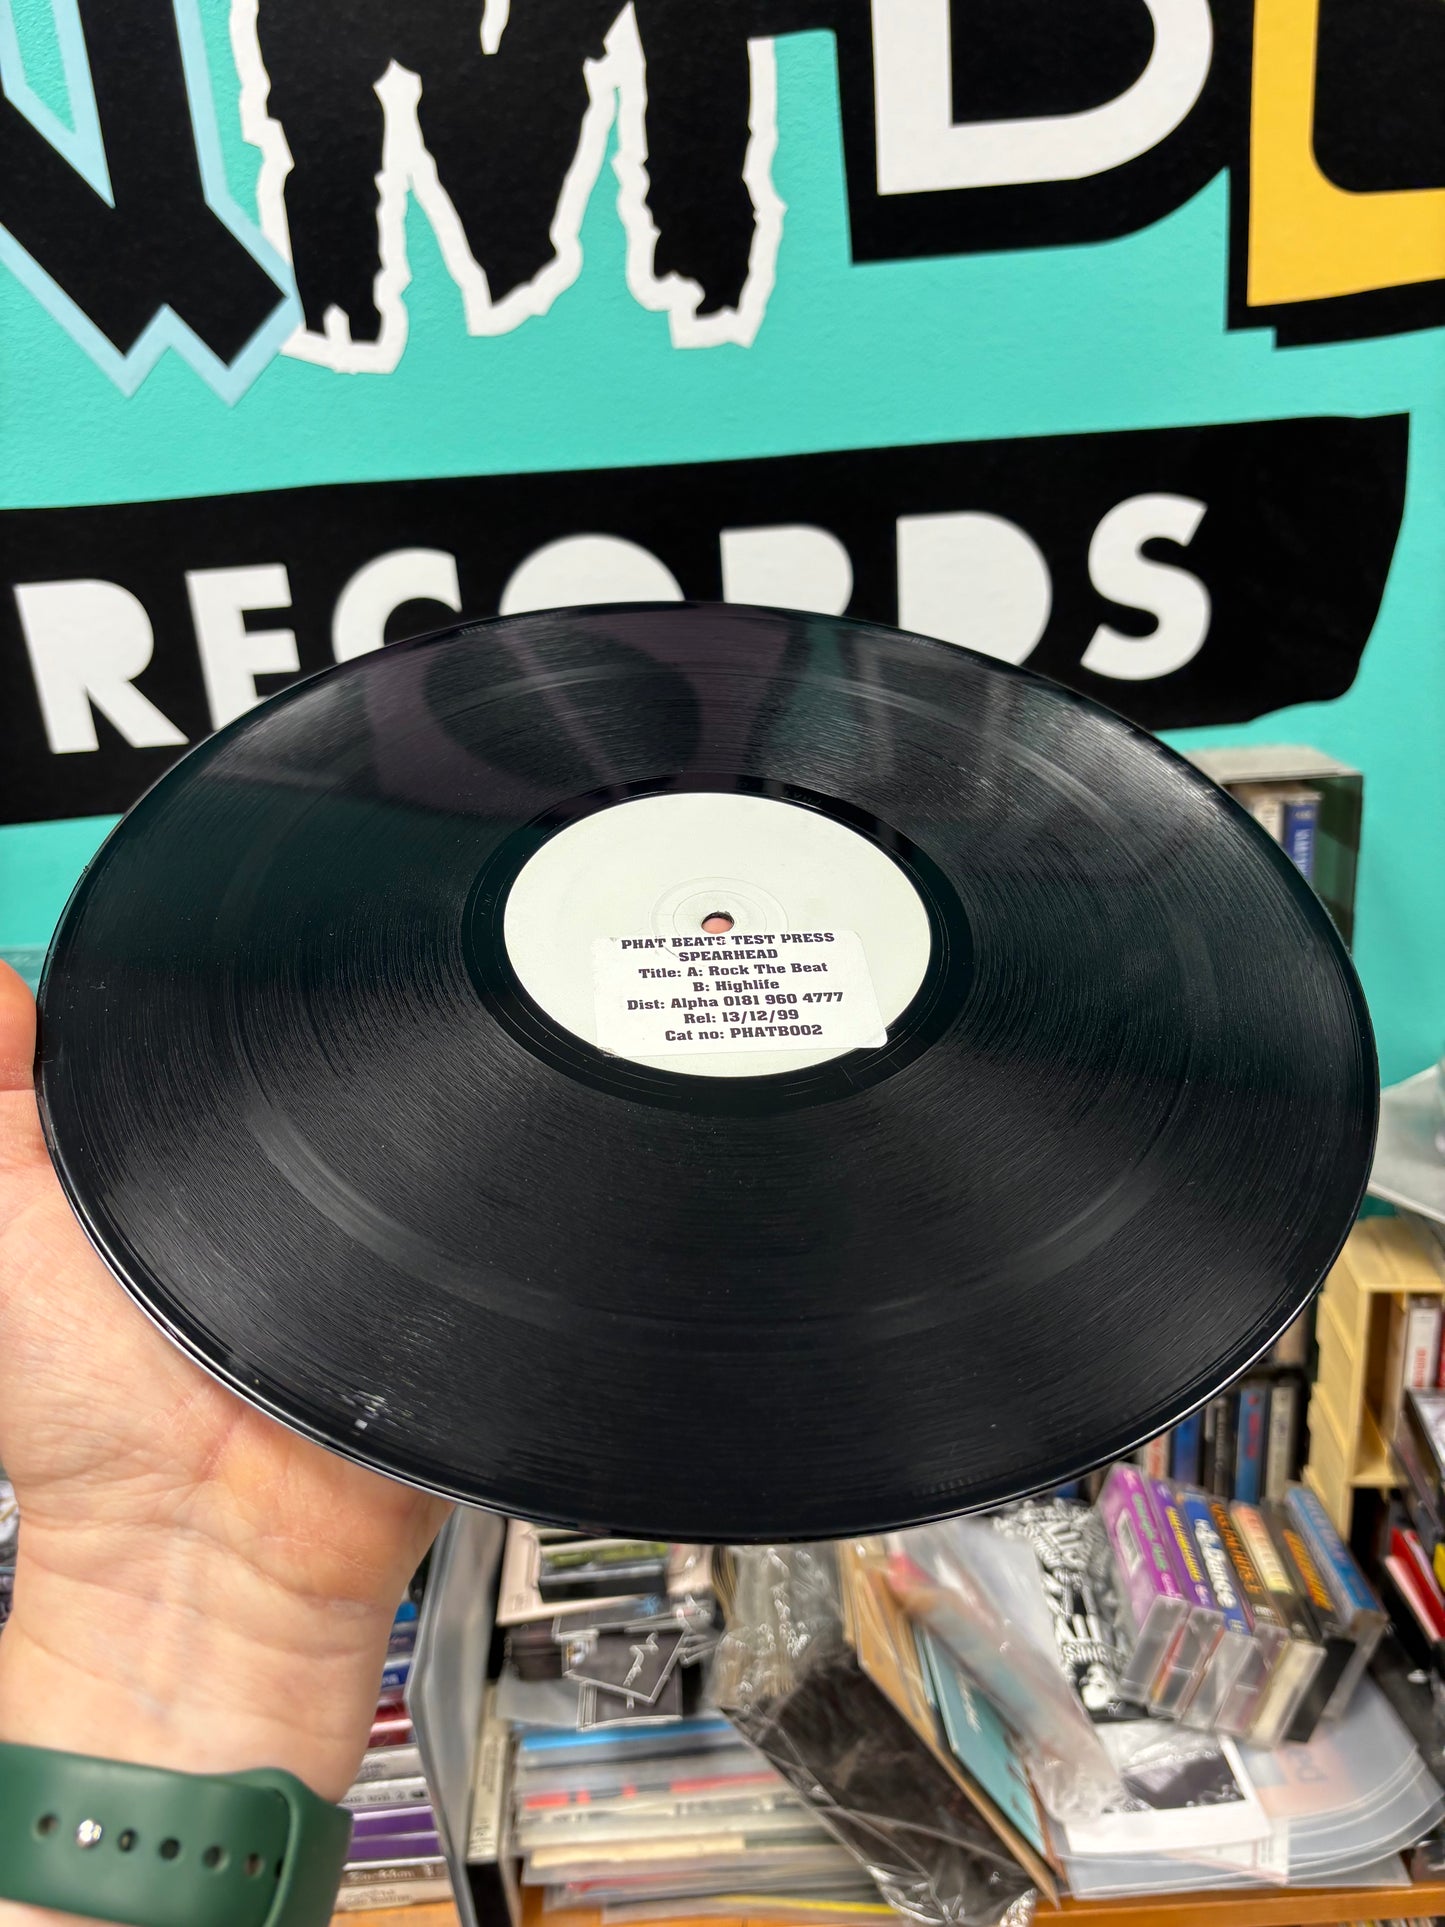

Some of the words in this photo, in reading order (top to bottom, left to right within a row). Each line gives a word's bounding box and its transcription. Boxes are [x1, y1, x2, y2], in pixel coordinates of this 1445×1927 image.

[621, 938, 666, 949] PHAT
[671, 936, 726, 948] BEATS
[731, 934, 775, 945] TEST
[780, 932, 835, 943] PRESS
[679, 949, 778, 962] SPEARHEAD
[638, 968, 681, 978] Title:
[687, 967, 703, 977] A:
[708, 965, 749, 976] Rock
[753, 964, 786, 974] The
[790, 962, 828, 973] Beat
[693, 981, 710, 992] B:
[715, 979, 780, 993] Highlife
[627, 999, 665, 1010] Dist:
[671, 997, 719, 1010] Alpha
[723, 994, 760, 1006] 0181
[765, 993, 798, 1005] 960
[802, 991, 843, 1003] 4777
[683, 1012, 716, 1024] Rel:
[722, 1009, 799, 1024] 13/12/99
[665, 1030, 693, 1041] Cat
[698, 1031, 724, 1040] no:
[729, 1024, 823, 1038] PHATB002
